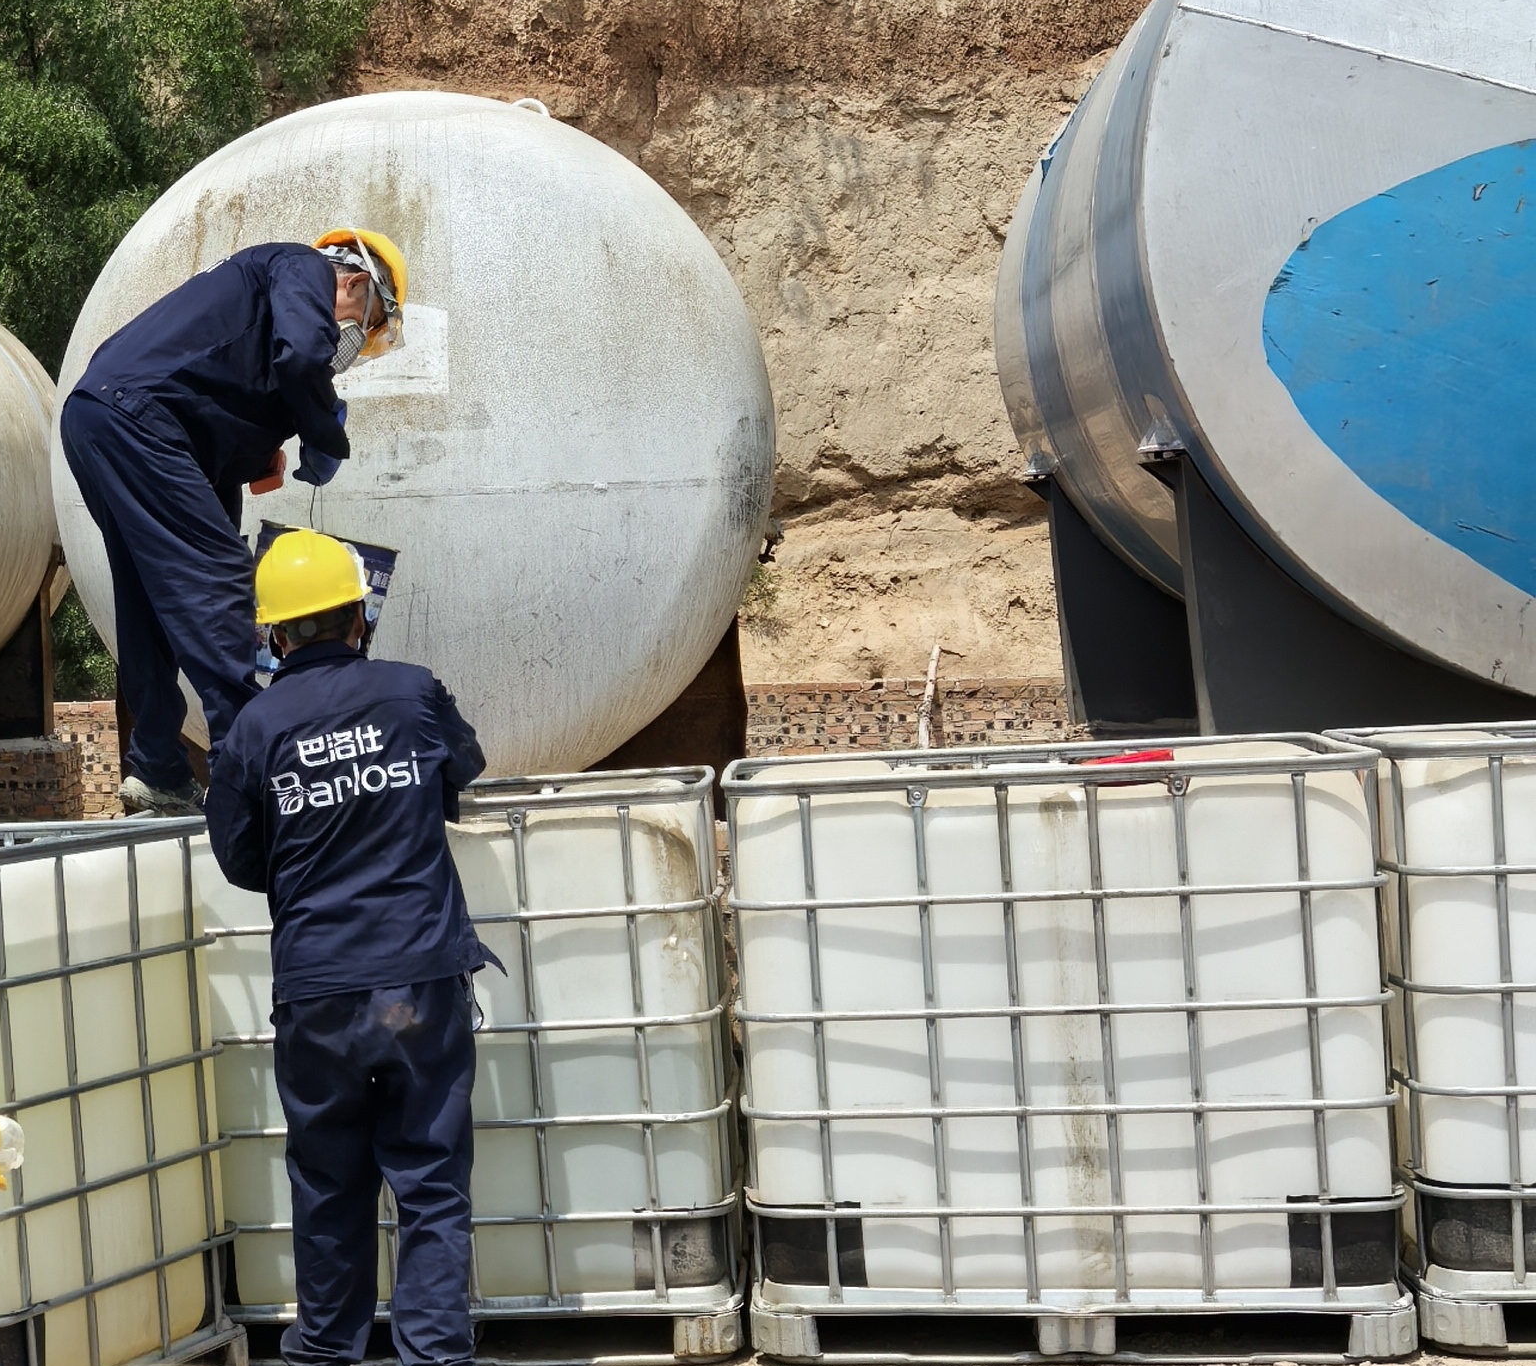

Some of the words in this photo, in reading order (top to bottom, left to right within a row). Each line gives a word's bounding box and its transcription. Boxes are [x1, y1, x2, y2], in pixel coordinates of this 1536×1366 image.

[297, 724, 384, 767] 巴洛仕
[269, 751, 421, 815] Barlosi
